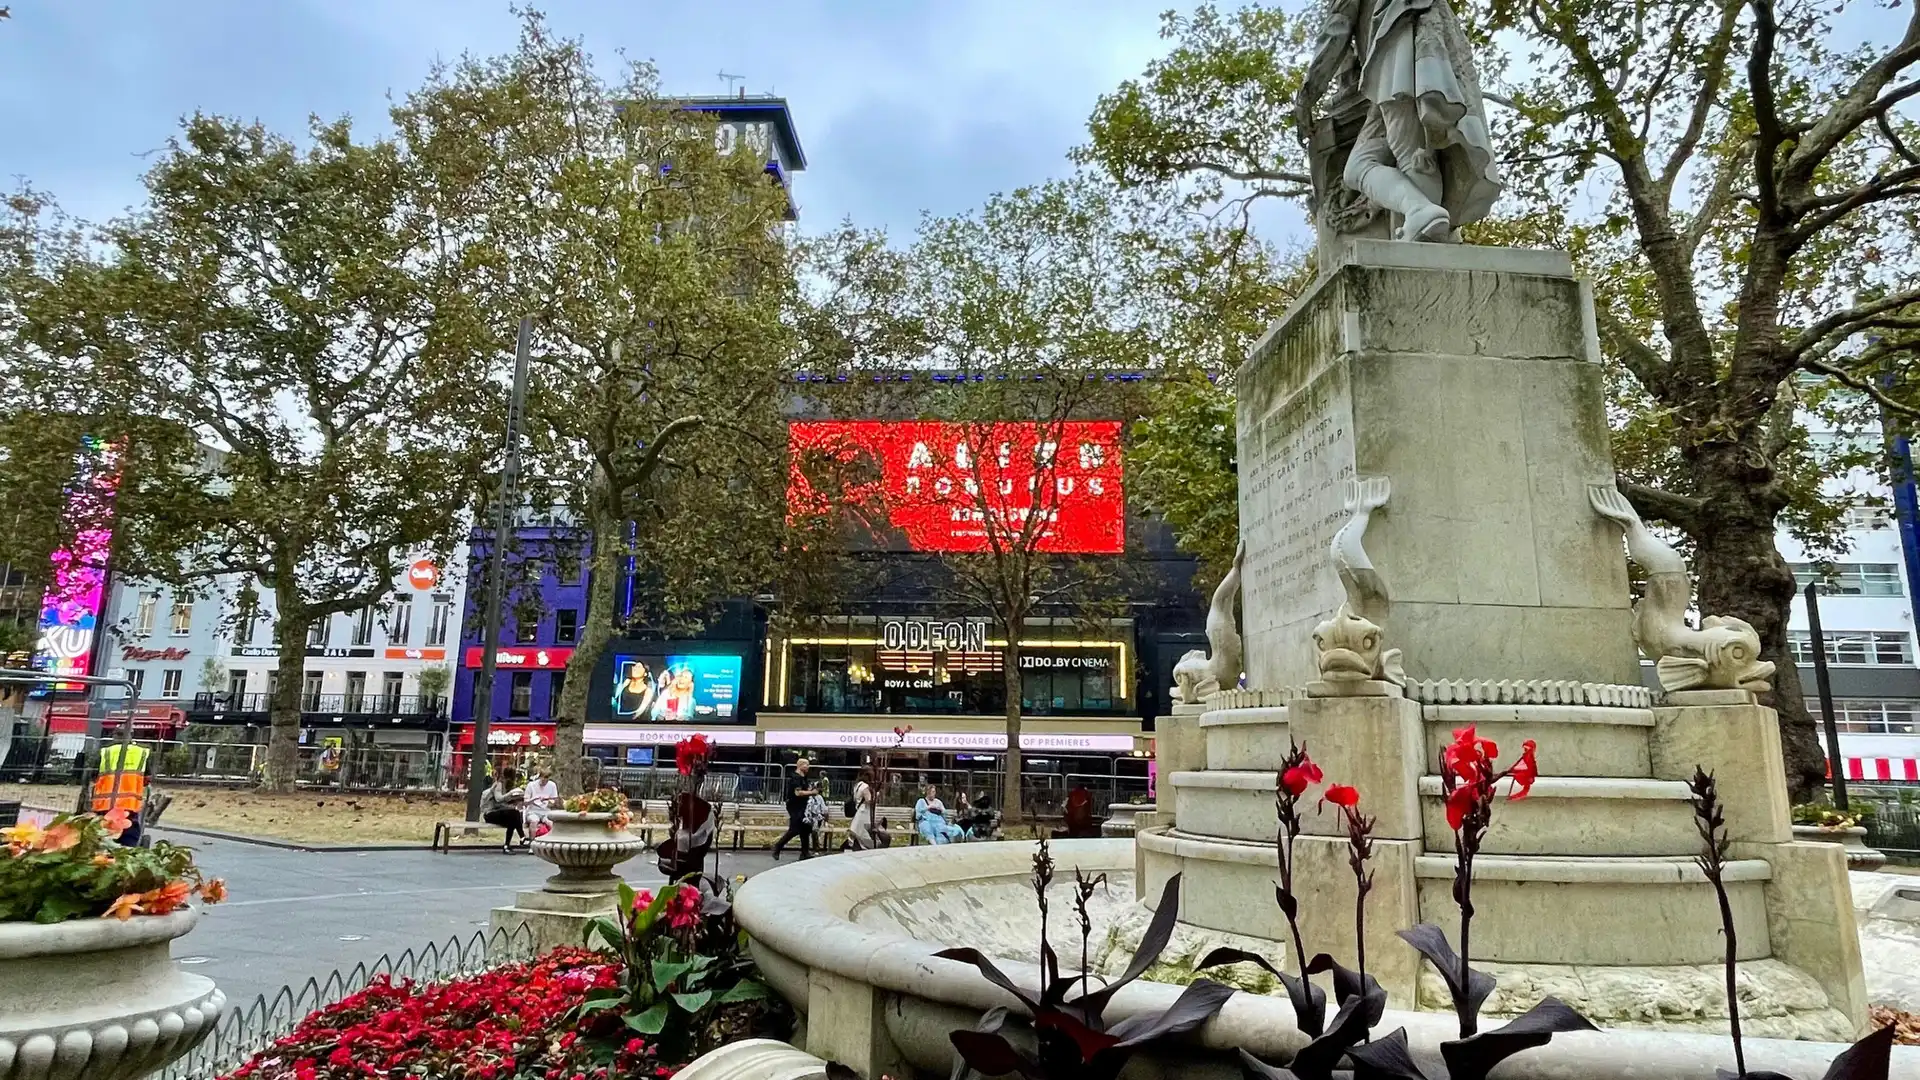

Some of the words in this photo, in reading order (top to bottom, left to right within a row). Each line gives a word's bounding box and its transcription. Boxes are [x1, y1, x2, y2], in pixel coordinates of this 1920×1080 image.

[37, 625, 91, 658] KU
[884, 621, 985, 652] ODEON
[1071, 657, 1109, 667] CINEMA
[640, 733, 665, 741] BOOK
[840, 735, 872, 743] ODEON
[902, 736, 949, 744] EICESTER
[952, 737, 989, 745] SQUARE
[1023, 738, 1035, 746] OF
[1038, 738, 1090, 747] PREMIERES
